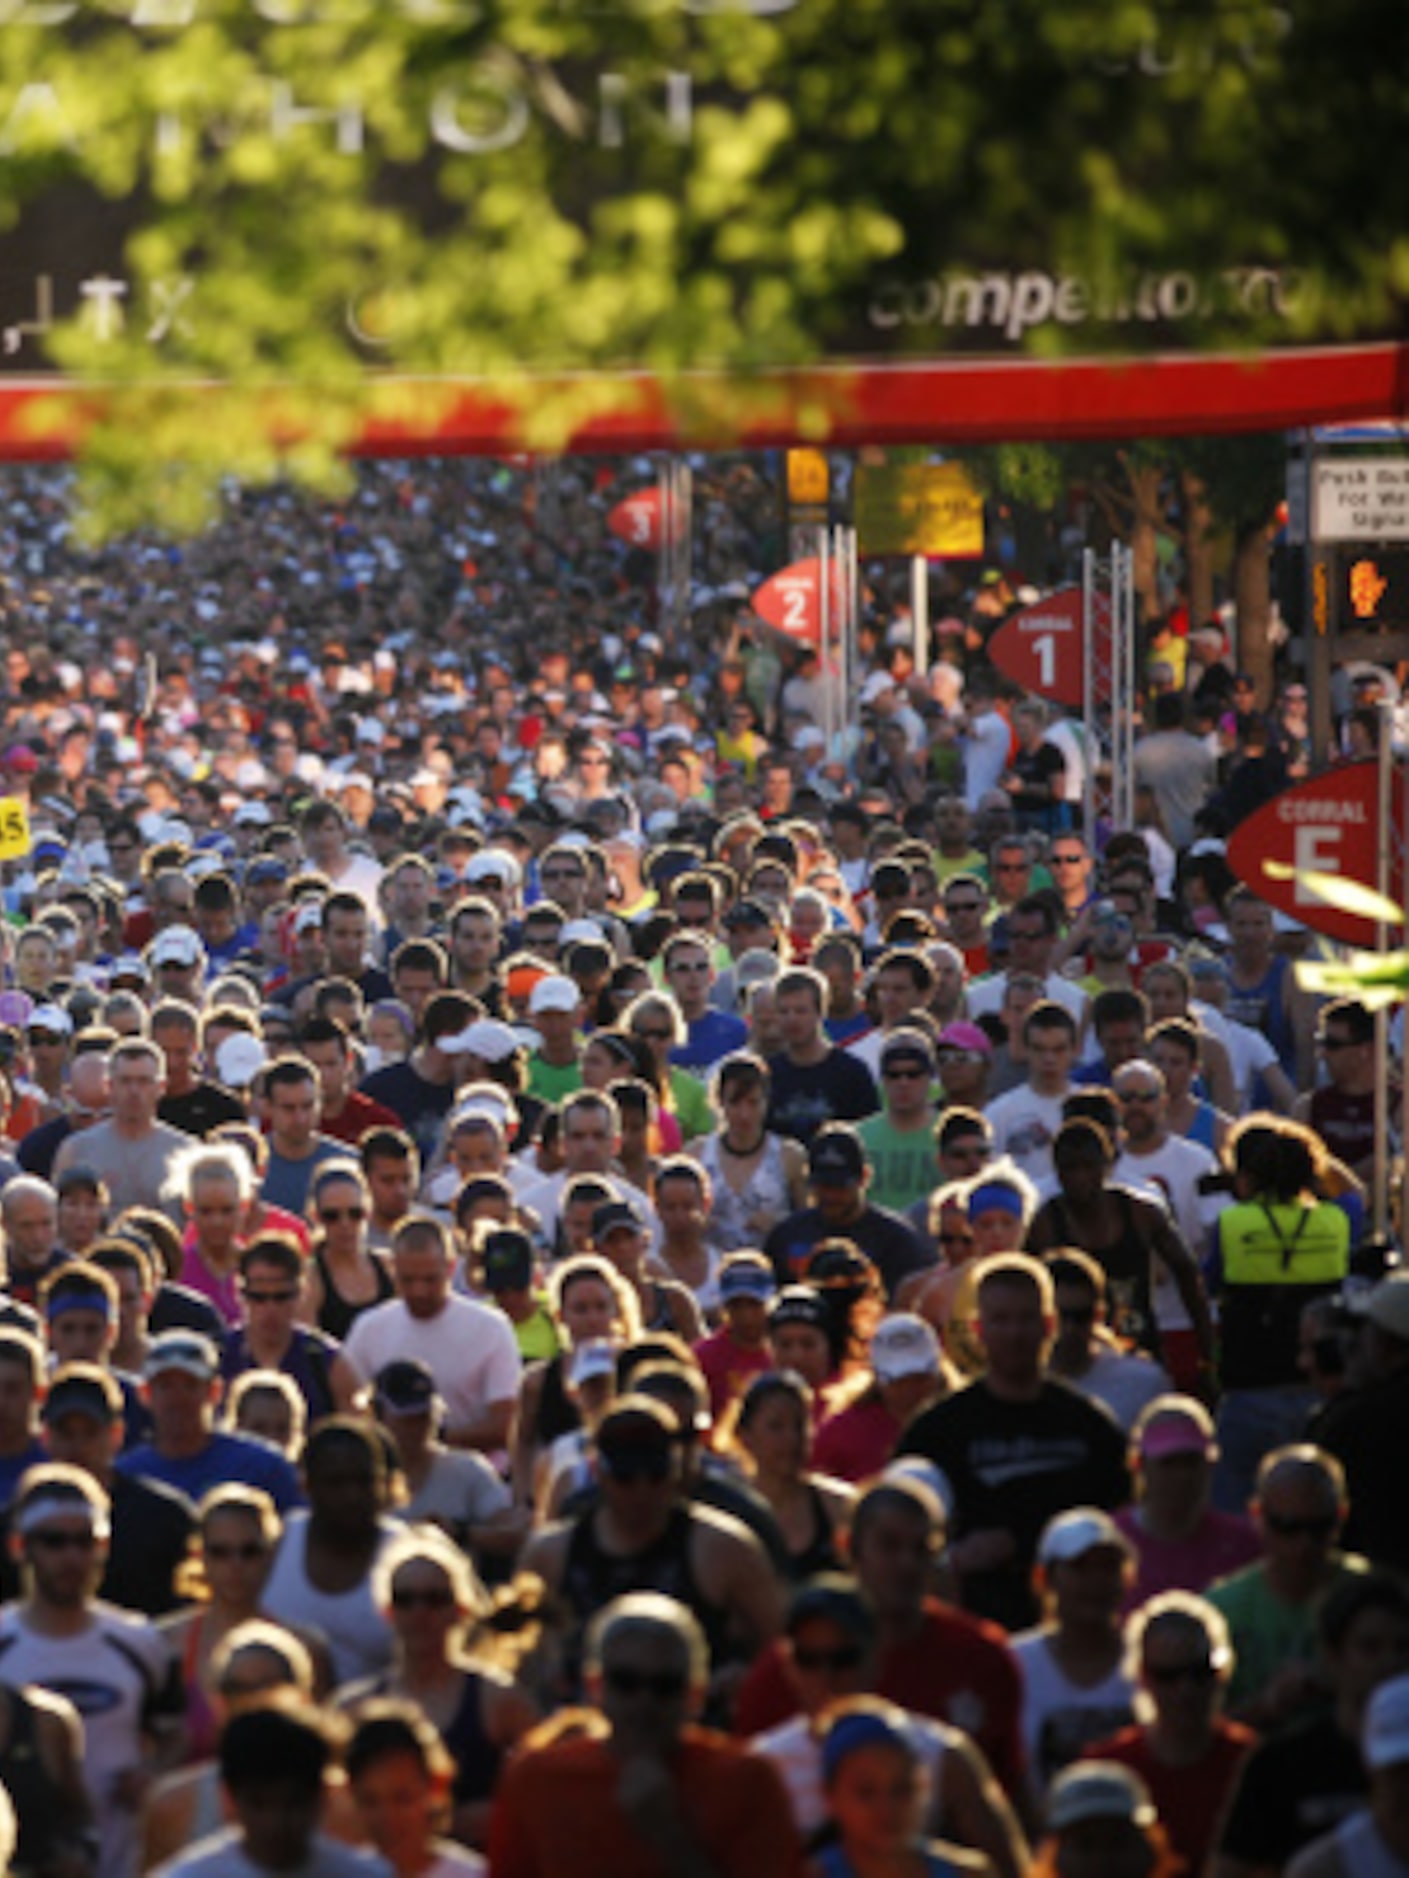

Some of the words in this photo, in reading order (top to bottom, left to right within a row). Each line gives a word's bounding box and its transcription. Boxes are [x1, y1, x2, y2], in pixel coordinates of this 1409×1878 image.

[783, 591, 807, 630] 2
[1032, 635, 1055, 687] 1
[1278, 800, 1367, 826] CORRAL
